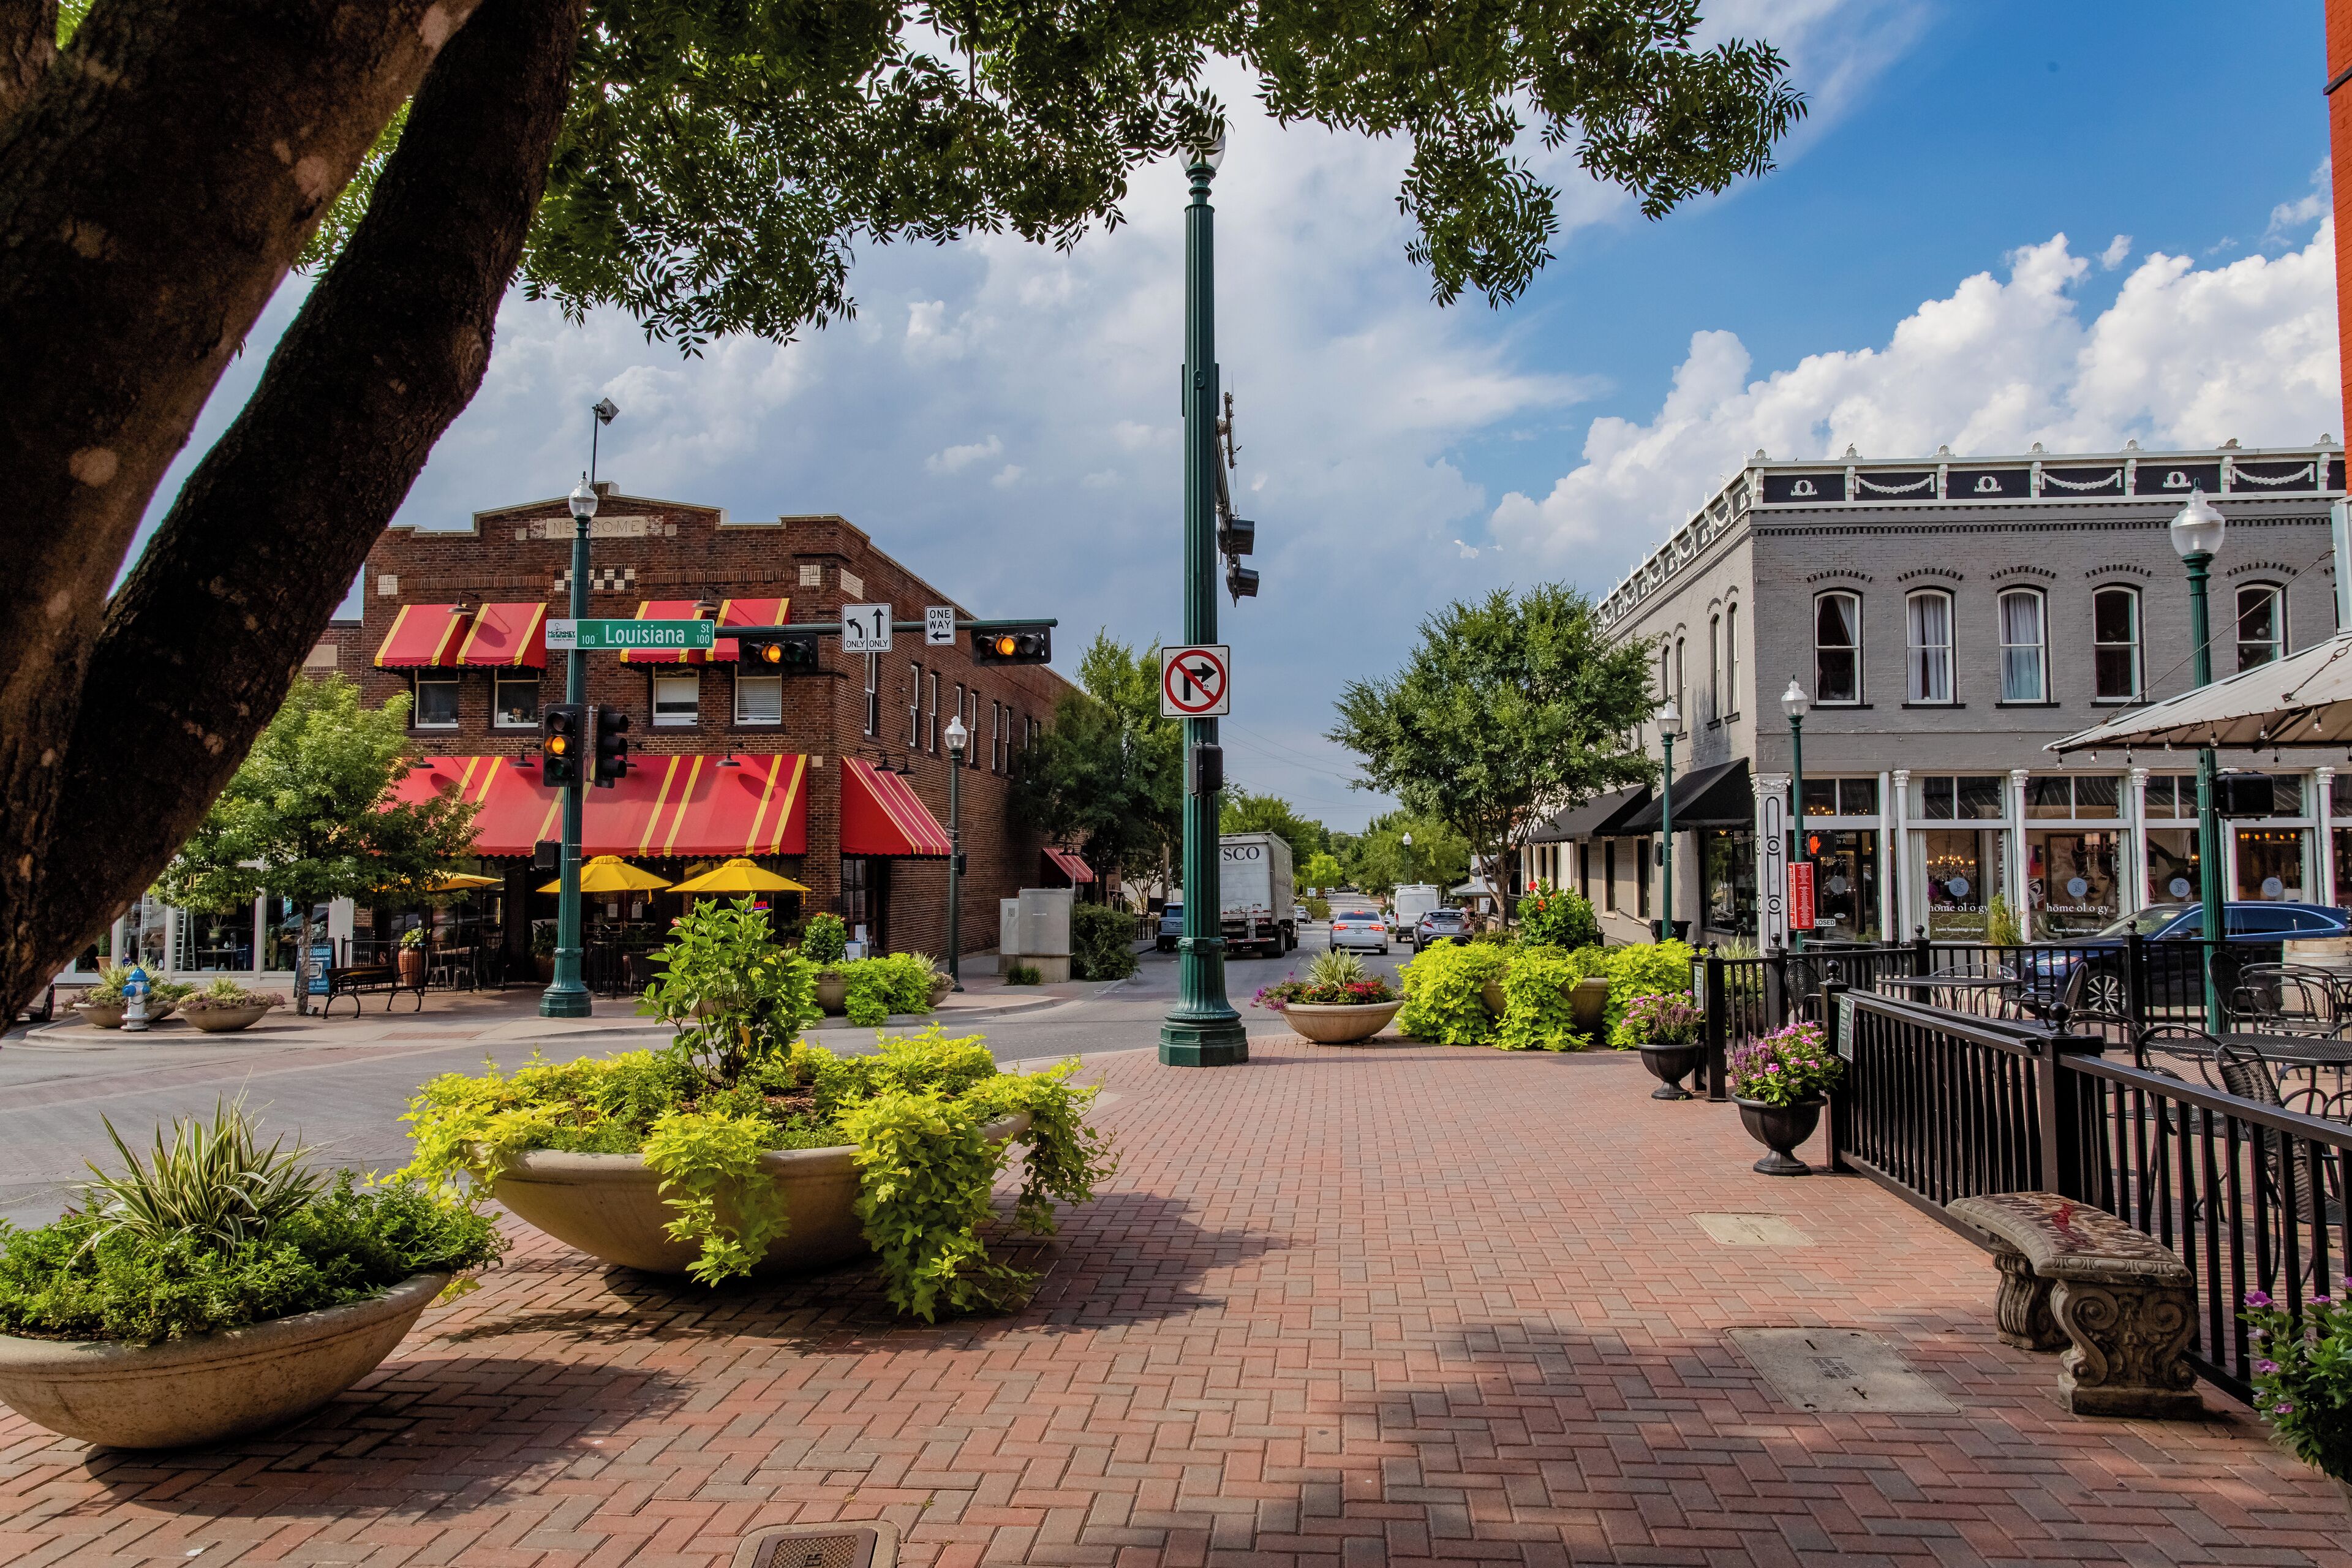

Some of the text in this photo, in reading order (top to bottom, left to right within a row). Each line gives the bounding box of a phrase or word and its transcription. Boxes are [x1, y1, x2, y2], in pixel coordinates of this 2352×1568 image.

[552, 520, 640, 535] NESOME
[929, 609, 951, 619] ONE
[701, 624, 710, 633] St
[929, 620, 951, 629] WAY
[605, 624, 685, 644] Louisiana
[582, 635, 595, 644] 100
[696, 635, 710, 644] 100
[1219, 846, 1260, 861] SCO
[313, 947, 331, 956] Lessons
